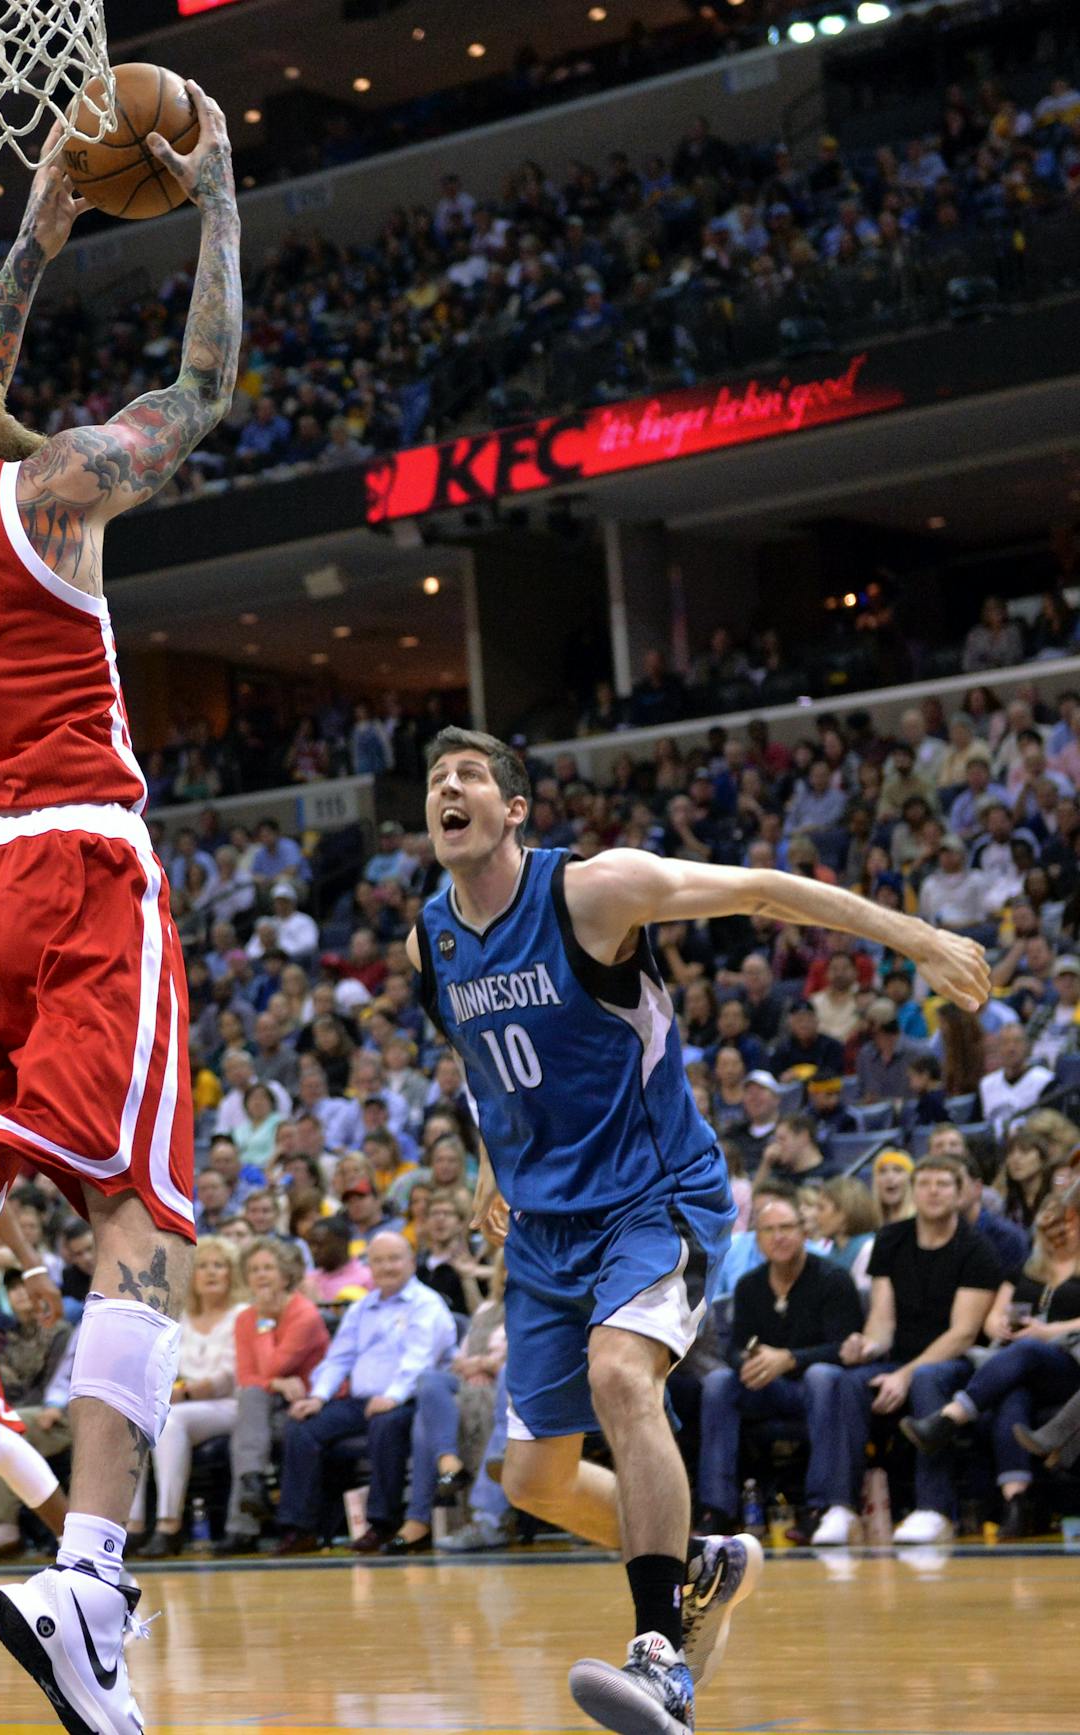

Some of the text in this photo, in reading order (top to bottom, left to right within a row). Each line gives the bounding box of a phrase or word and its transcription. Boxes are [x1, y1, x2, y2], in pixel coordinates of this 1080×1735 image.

[431, 416, 588, 506] KFC
[447, 963, 562, 1026] MINNESOTA
[480, 1023, 543, 1093] 10
